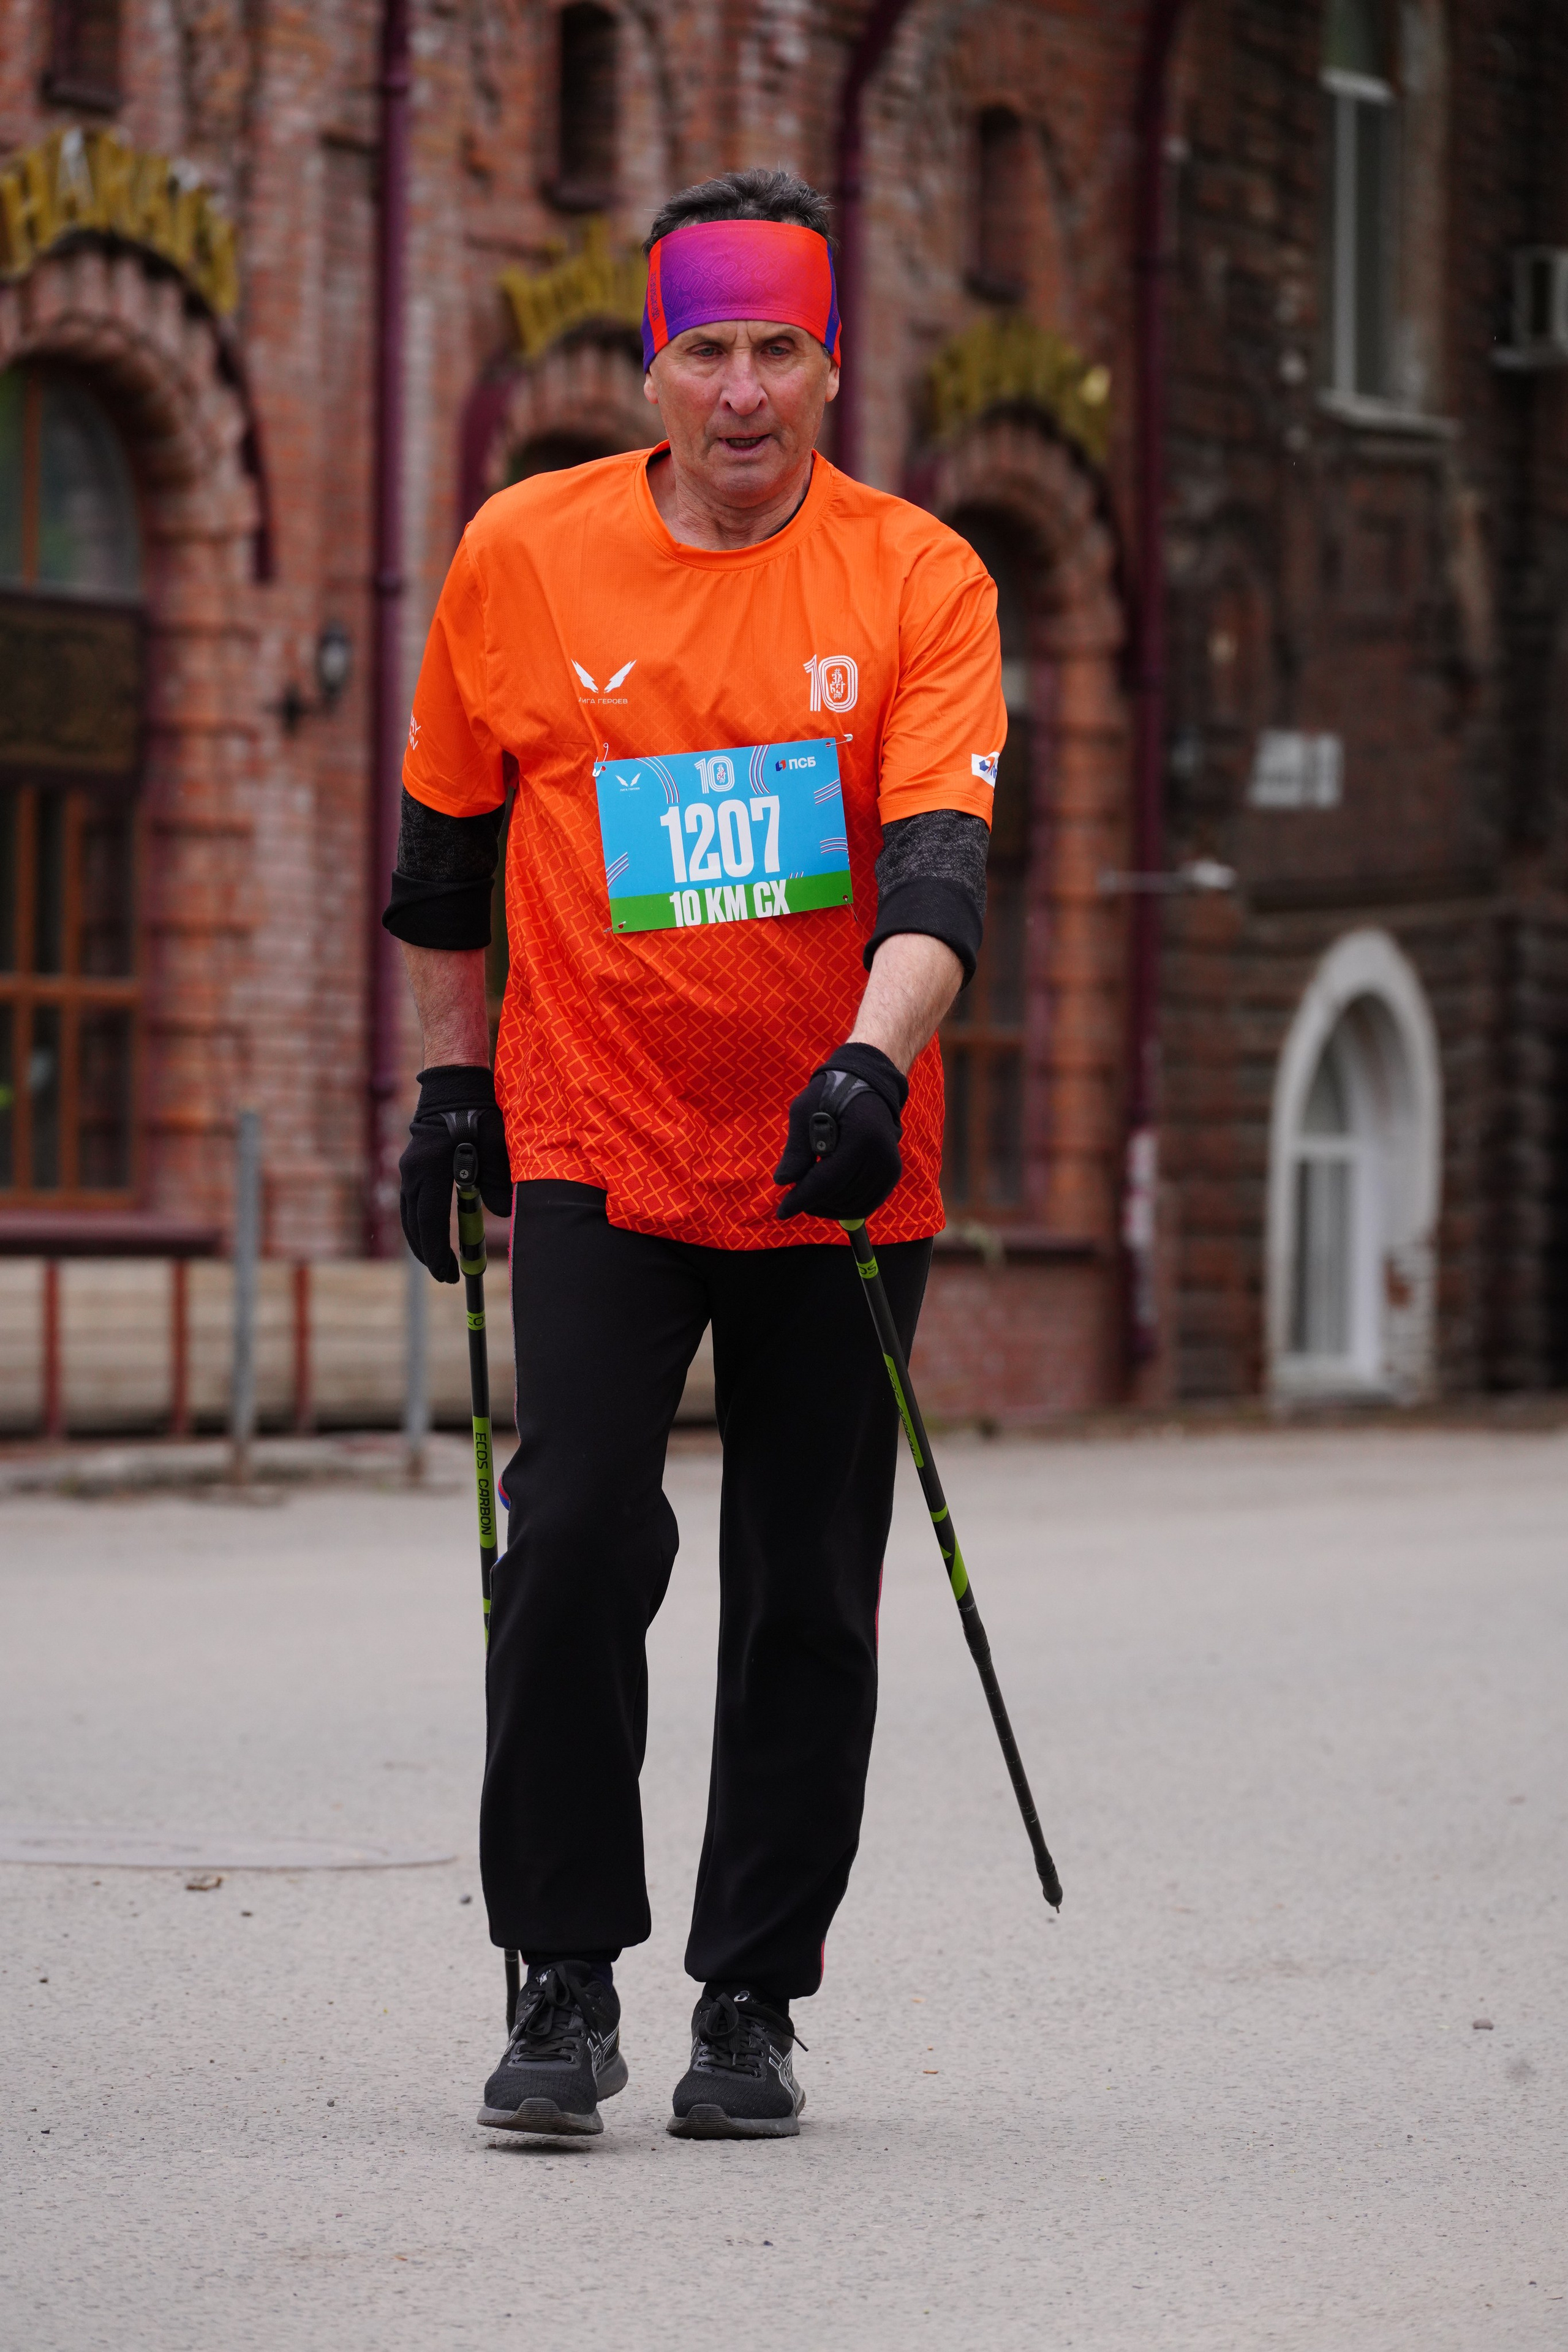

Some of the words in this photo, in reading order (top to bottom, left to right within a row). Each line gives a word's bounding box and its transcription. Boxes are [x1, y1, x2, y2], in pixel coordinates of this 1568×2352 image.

[802, 654, 858, 713] 10
[694, 756, 735, 794] 10
[788, 756, 816, 770] ПСБ
[660, 795, 781, 884] 1207
[669, 889, 702, 928] 10
[475, 1432, 489, 1470] ECOS
[478, 1479, 492, 1536] CARBON
